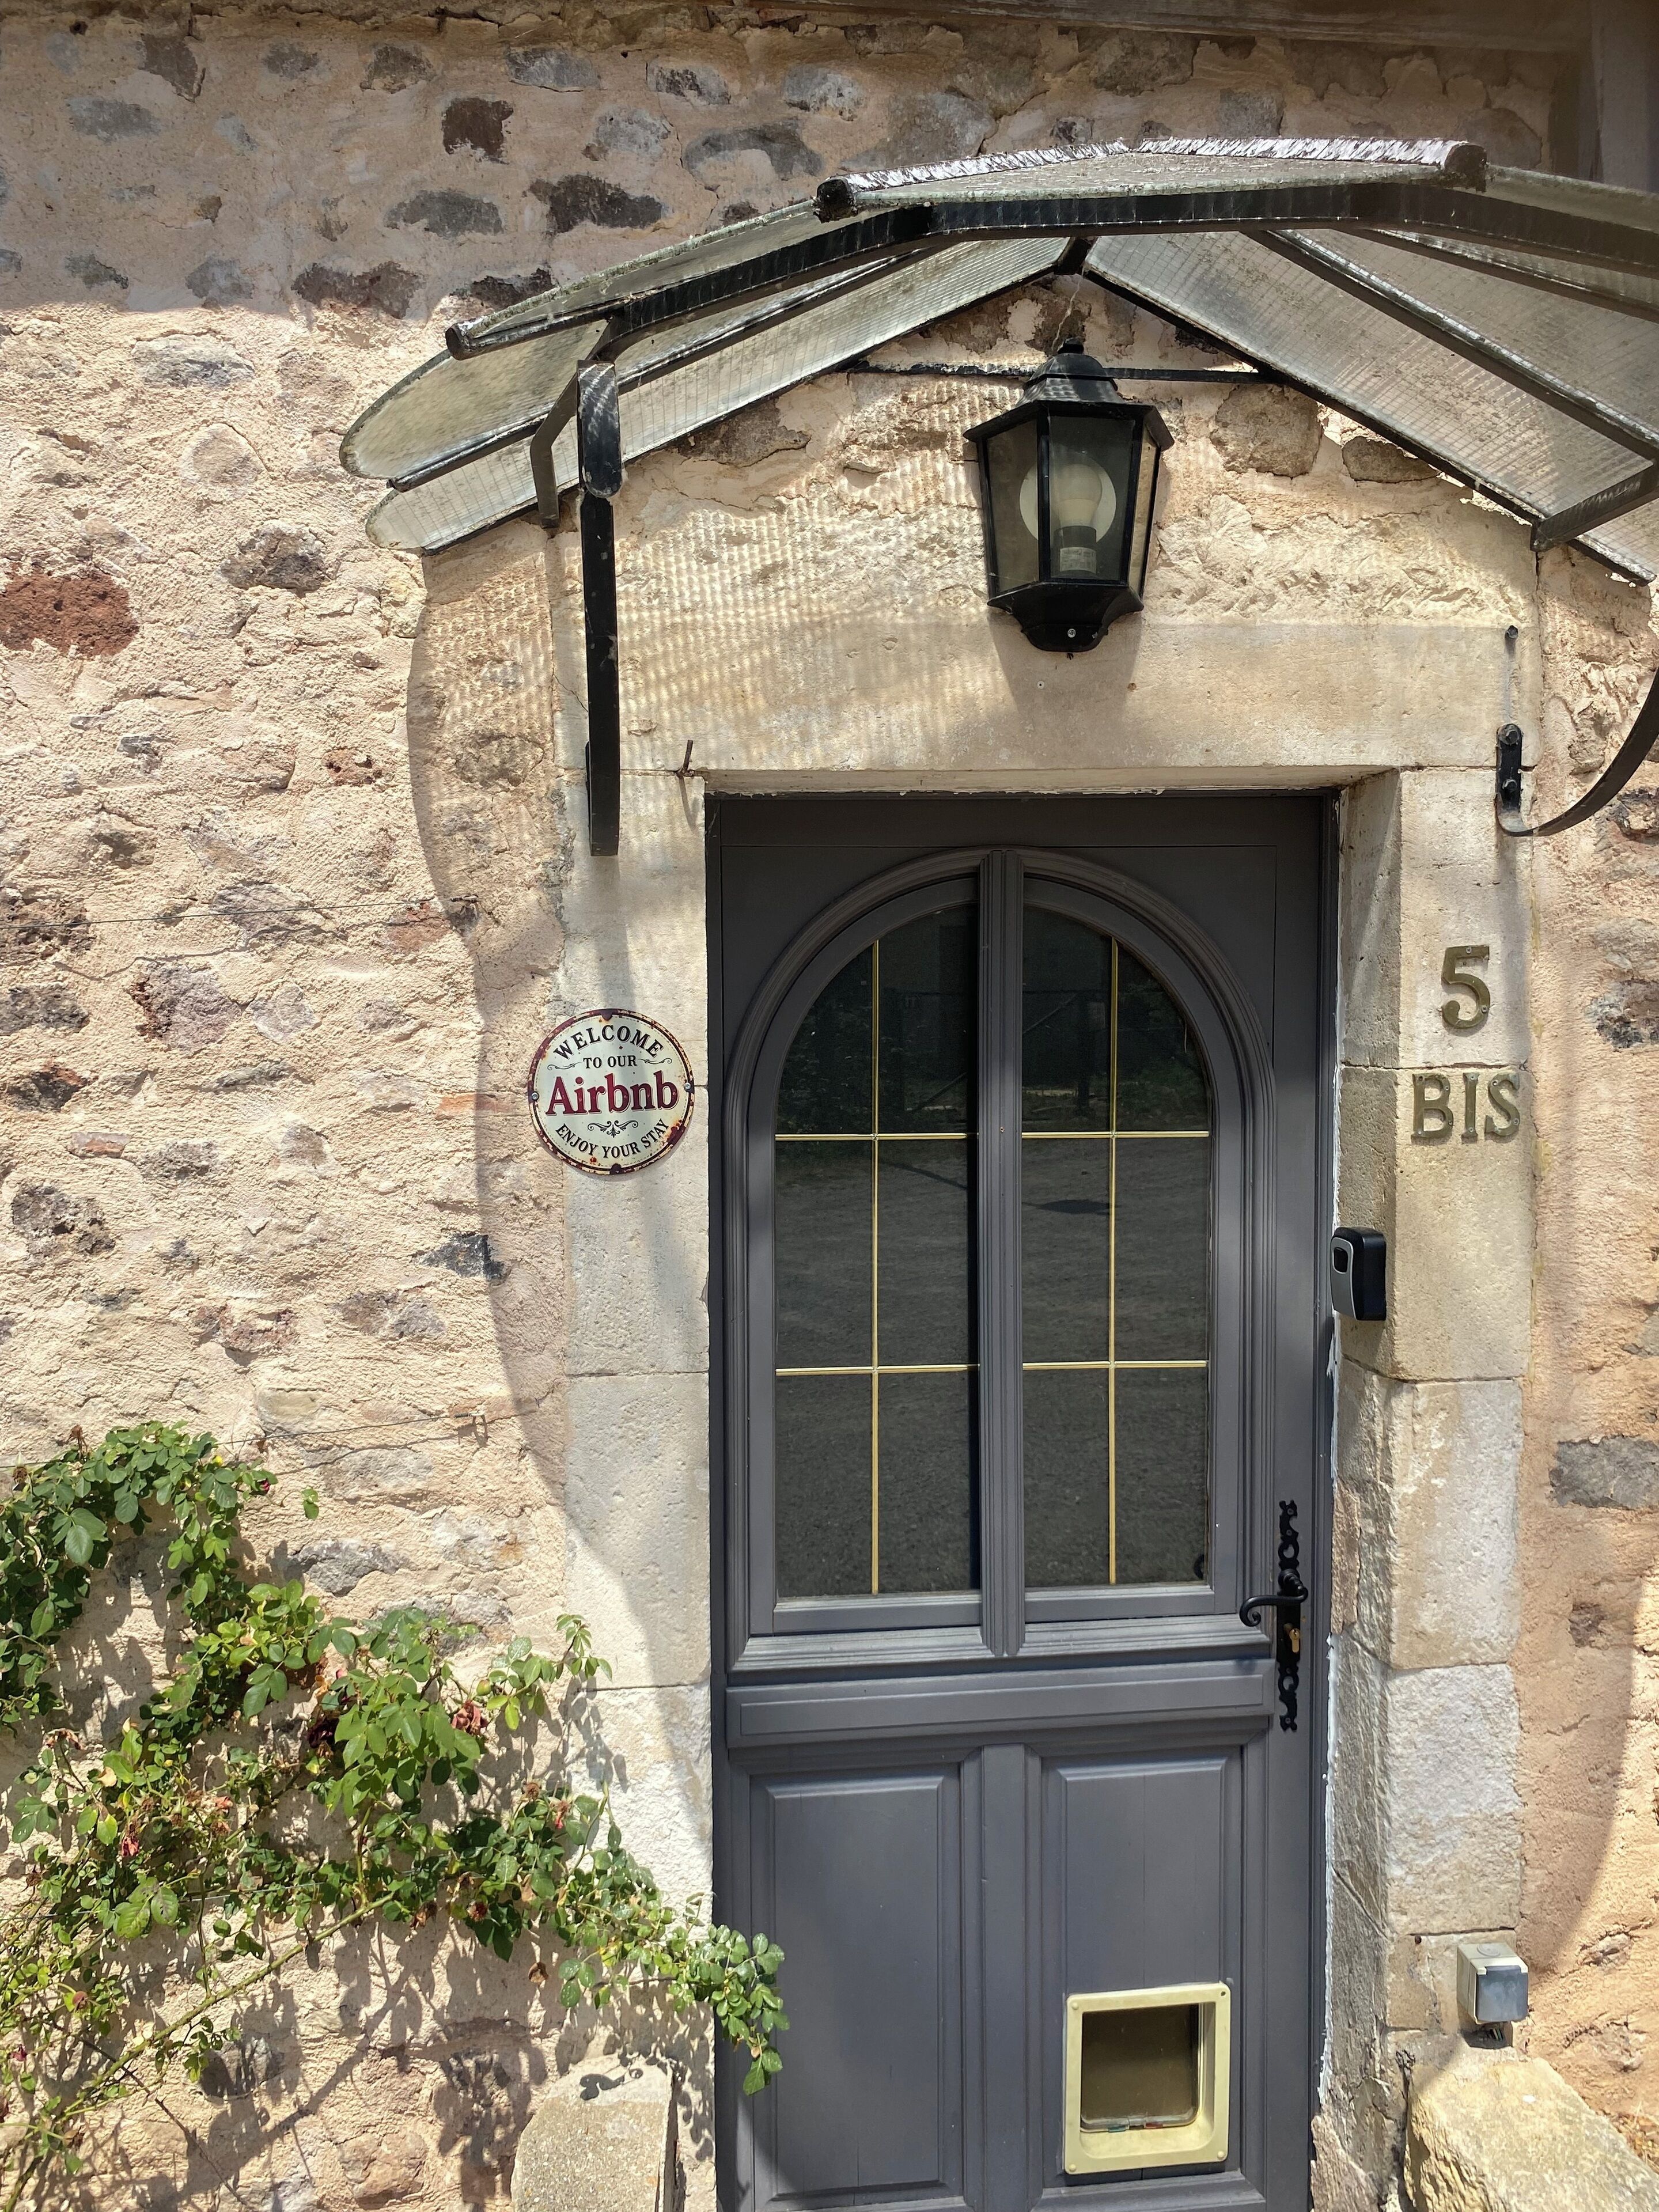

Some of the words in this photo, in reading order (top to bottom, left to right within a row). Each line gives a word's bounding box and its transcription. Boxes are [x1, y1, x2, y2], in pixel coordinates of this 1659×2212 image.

[1441, 945, 1490, 1029] 5
[554, 1025, 664, 1058] WELCOME
[583, 1057, 602, 1069] TO
[607, 1055, 637, 1067] OUR
[546, 1070, 680, 1115] Airbnb
[1411, 1072, 1520, 1138] BIS
[555, 1123, 598, 1156] ENJOY
[602, 1142, 641, 1158] YOUR
[641, 1118, 669, 1149] STAY
